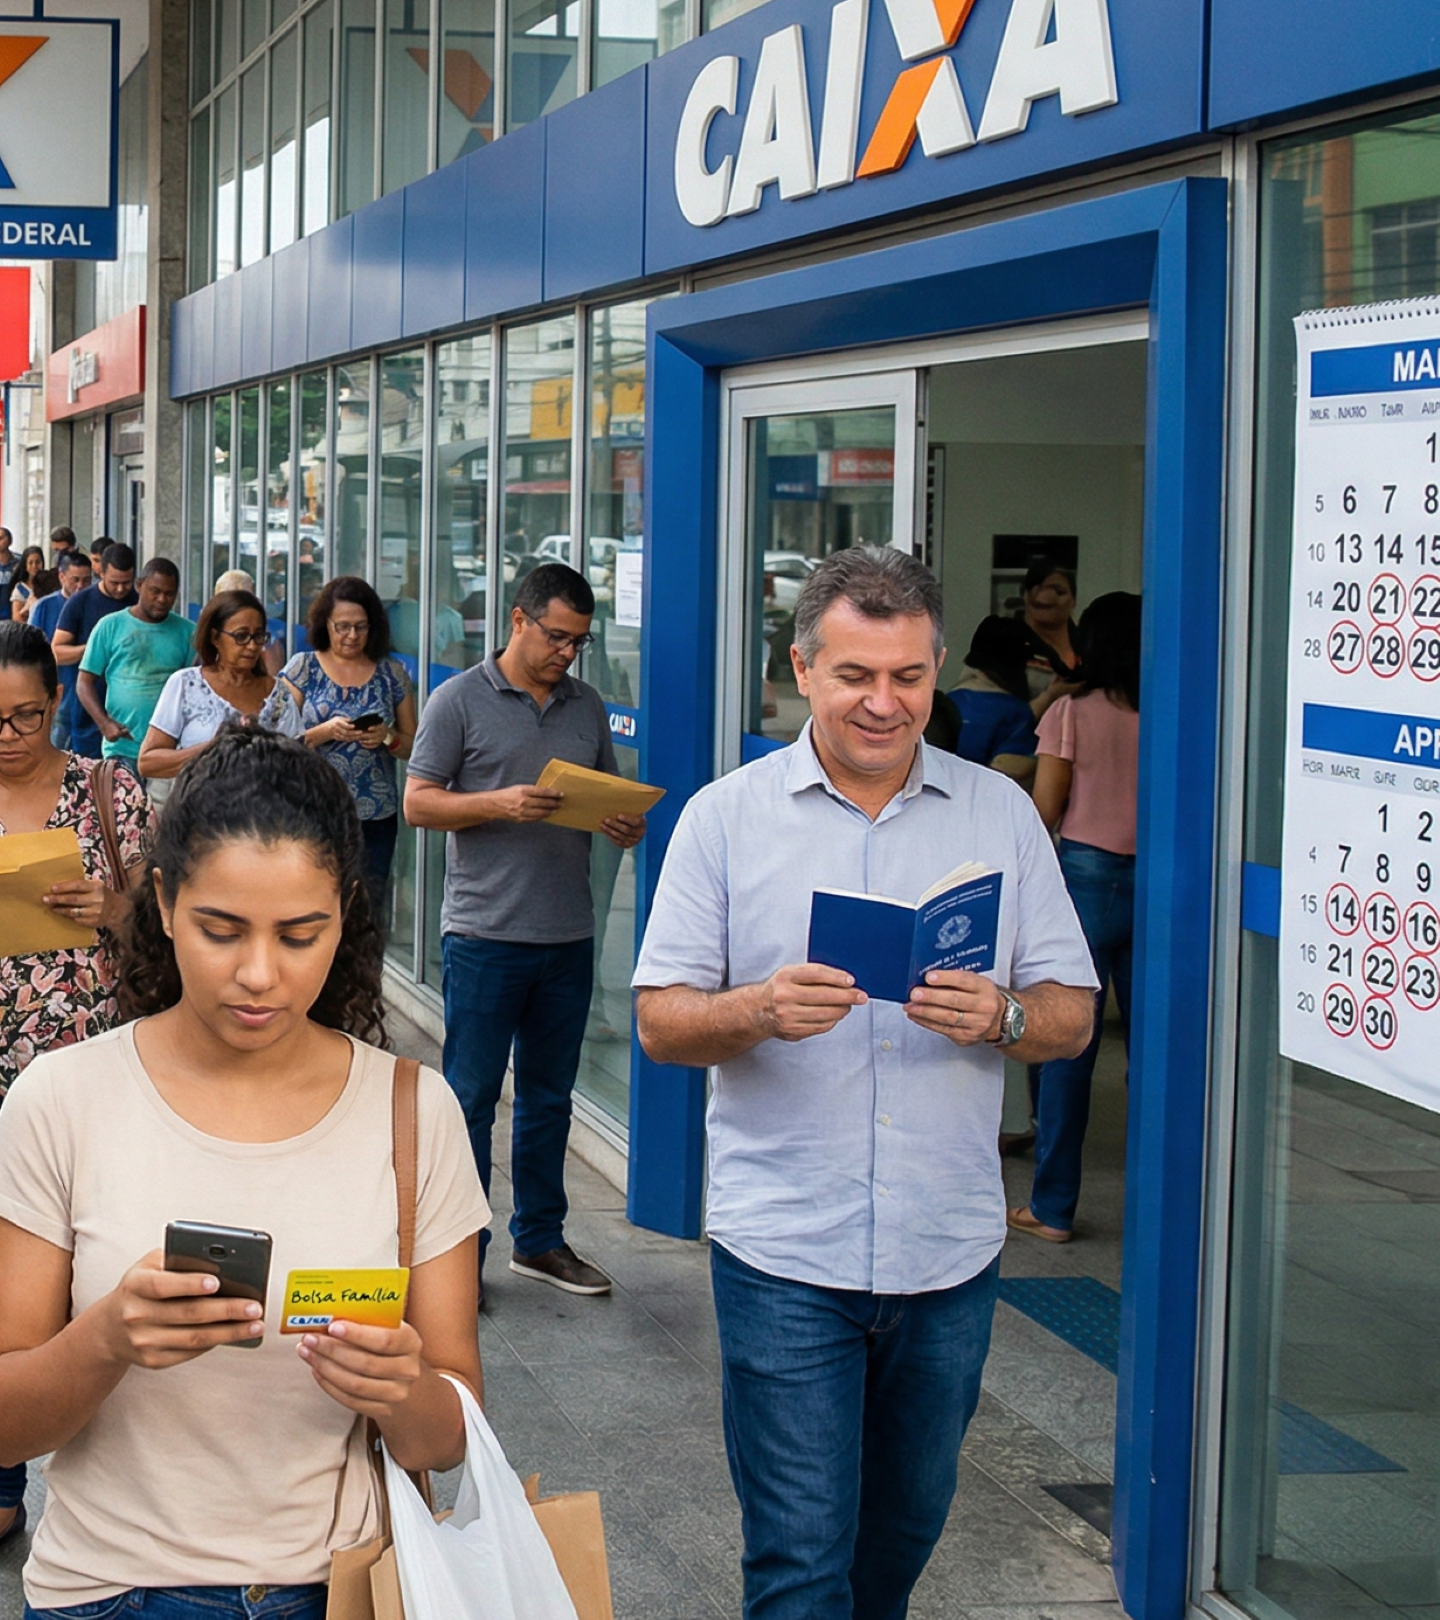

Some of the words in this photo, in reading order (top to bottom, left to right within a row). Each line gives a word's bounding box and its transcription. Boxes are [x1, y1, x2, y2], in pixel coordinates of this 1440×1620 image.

[674, 0, 1117, 228] CAIXA
[1393, 347, 1440, 382] MA
[1426, 432, 1436, 463] 1
[1315, 494, 1324, 513] 5
[1343, 485, 1357, 514] 6
[1382, 485, 1397, 514] 7
[1424, 484, 1439, 514] 8
[1308, 542, 1325, 562] 10
[1335, 533, 1363, 563] 13
[1374, 533, 1403, 564] 14
[1415, 534, 1440, 566] 15
[1307, 590, 1323, 609] 14
[1332, 581, 1360, 613] 20
[1372, 584, 1400, 614] 21
[1413, 586, 1440, 618] 22
[1304, 638, 1321, 658] 28
[1331, 632, 1360, 662] 27
[1371, 635, 1400, 667] 28
[1412, 638, 1440, 670] 29
[1378, 803, 1388, 833] 1
[1417, 811, 1433, 842] 2
[1338, 844, 1352, 873] 7
[1376, 853, 1390, 883] 8
[1417, 862, 1431, 893] 9
[1301, 894, 1317, 914] 15
[1330, 894, 1357, 927] 14
[1368, 902, 1395, 935] 15
[1408, 912, 1437, 946] 16
[1300, 943, 1317, 963] 16
[1327, 943, 1353, 977] 21
[1366, 954, 1395, 988] 22
[1406, 964, 1435, 999] 23
[1297, 991, 1315, 1013] 20
[1327, 993, 1354, 1026] 29
[1365, 1005, 1393, 1039] 30
[291, 1289, 337, 1304] Bolsa
